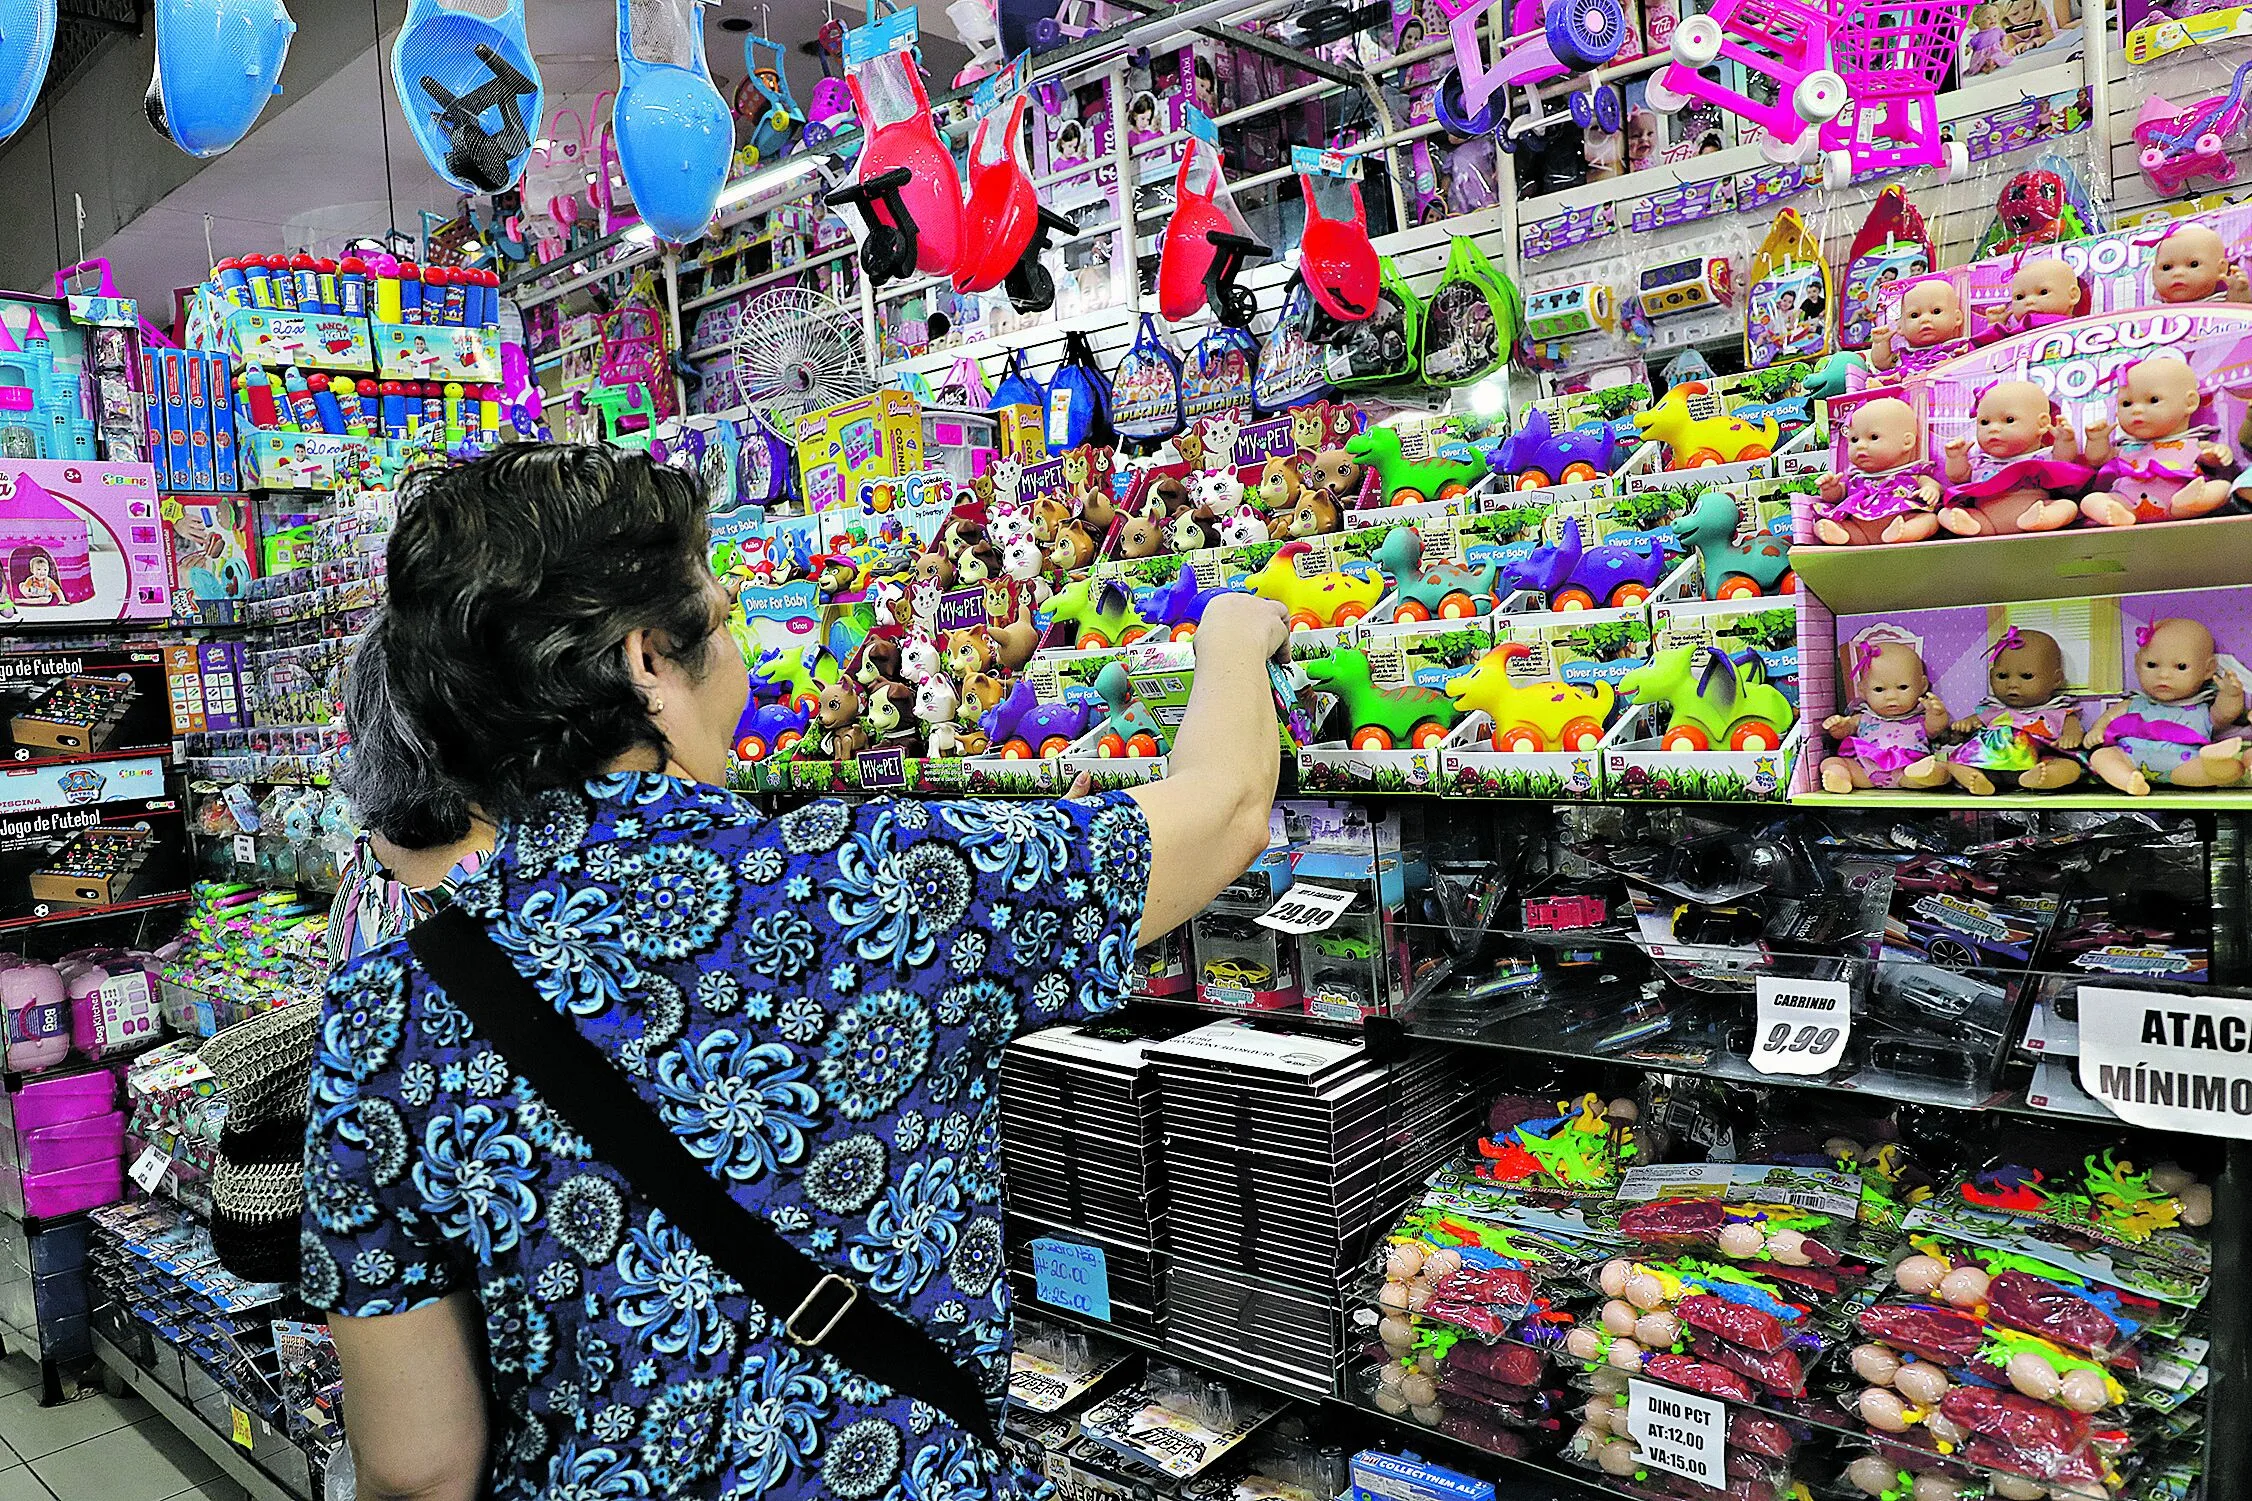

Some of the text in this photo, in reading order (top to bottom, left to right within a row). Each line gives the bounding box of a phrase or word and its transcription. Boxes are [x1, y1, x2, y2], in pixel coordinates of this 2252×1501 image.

[2032, 314, 2193, 362] new
[888, 400, 915, 417] Beauty
[1761, 409, 1775, 419] For
[1776, 404, 1800, 415] Baby
[799, 416, 828, 440] Beauty
[1238, 426, 1290, 459] MY PET
[1022, 466, 1062, 494] MY PET
[861, 474, 953, 515] Soft Cars
[727, 522, 737, 533] For
[738, 519, 759, 532] Baby
[1633, 536, 1649, 546] For
[1470, 547, 1529, 561] Diver For Baby
[746, 593, 807, 611] Diver For Baby
[940, 595, 983, 625] MY PET
[792, 621, 808, 630] Dinos
[15, 659, 32, 676] de
[34, 657, 83, 676] Futebol
[1763, 658, 1780, 667] For
[1418, 674, 1441, 684] Diver
[1566, 668, 1591, 679] Diver
[1592, 667, 1608, 677] For
[1067, 691, 1083, 700] Diver
[861, 756, 900, 783] MY PET
[1448, 758, 1457, 766] +3
[1611, 757, 1623, 765] +3
[58, 773, 107, 791] PAW
[0, 819, 32, 839] Jogo
[34, 815, 50, 832] de
[52, 809, 101, 830] Futebol
[1774, 993, 1836, 1011] CARRINHO
[42, 1007, 57, 1033] Bag
[1763, 1023, 1840, 1055] 9,99
[2140, 1009, 2252, 1054] ATAC
[2099, 1061, 2252, 1116] MÍNIMO
[281, 1334, 305, 1346] SUPER
[1648, 1396, 1711, 1427] DINO PCT
[1379, 1460, 1427, 1480] COLLECT
[1426, 1473, 1455, 1489] THEM
[1455, 1483, 1477, 1496] ALL
